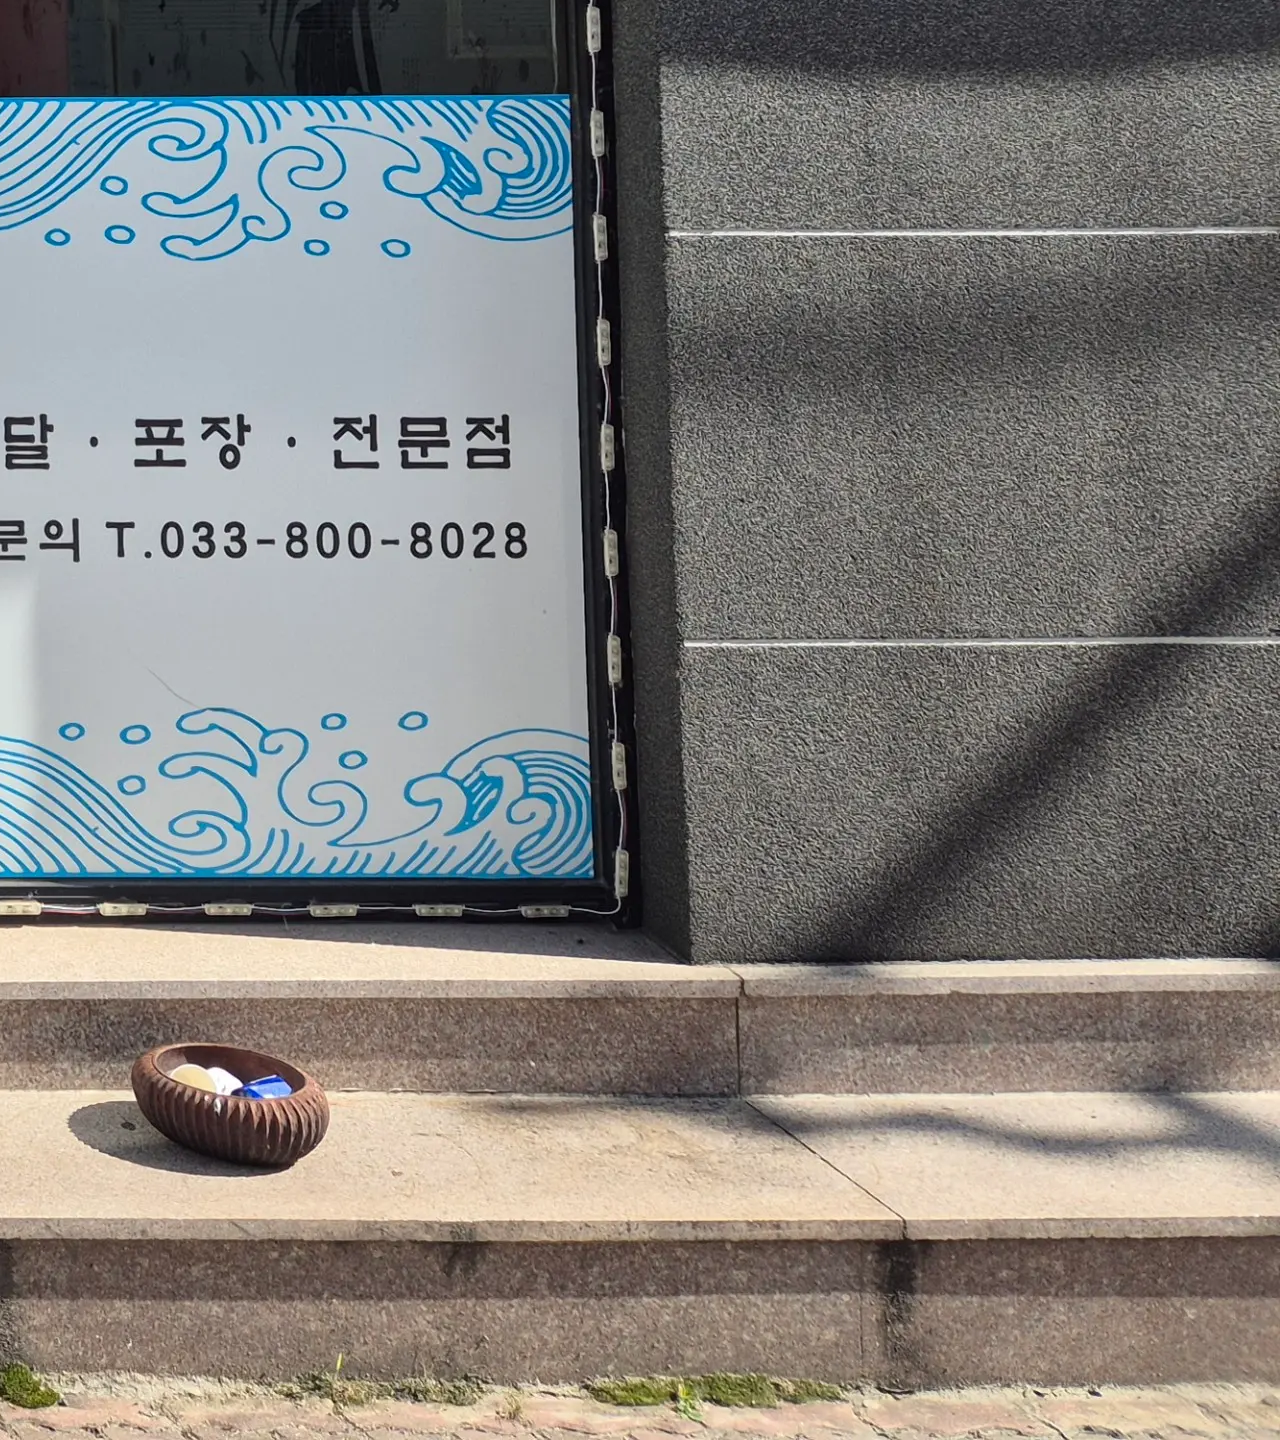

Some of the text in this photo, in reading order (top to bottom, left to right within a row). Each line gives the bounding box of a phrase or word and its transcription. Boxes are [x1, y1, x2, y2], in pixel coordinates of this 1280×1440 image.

[134, 414, 252, 470] 포장
[333, 414, 512, 470] 전문점
[105, 520, 528, 560] T.033-800-8028
